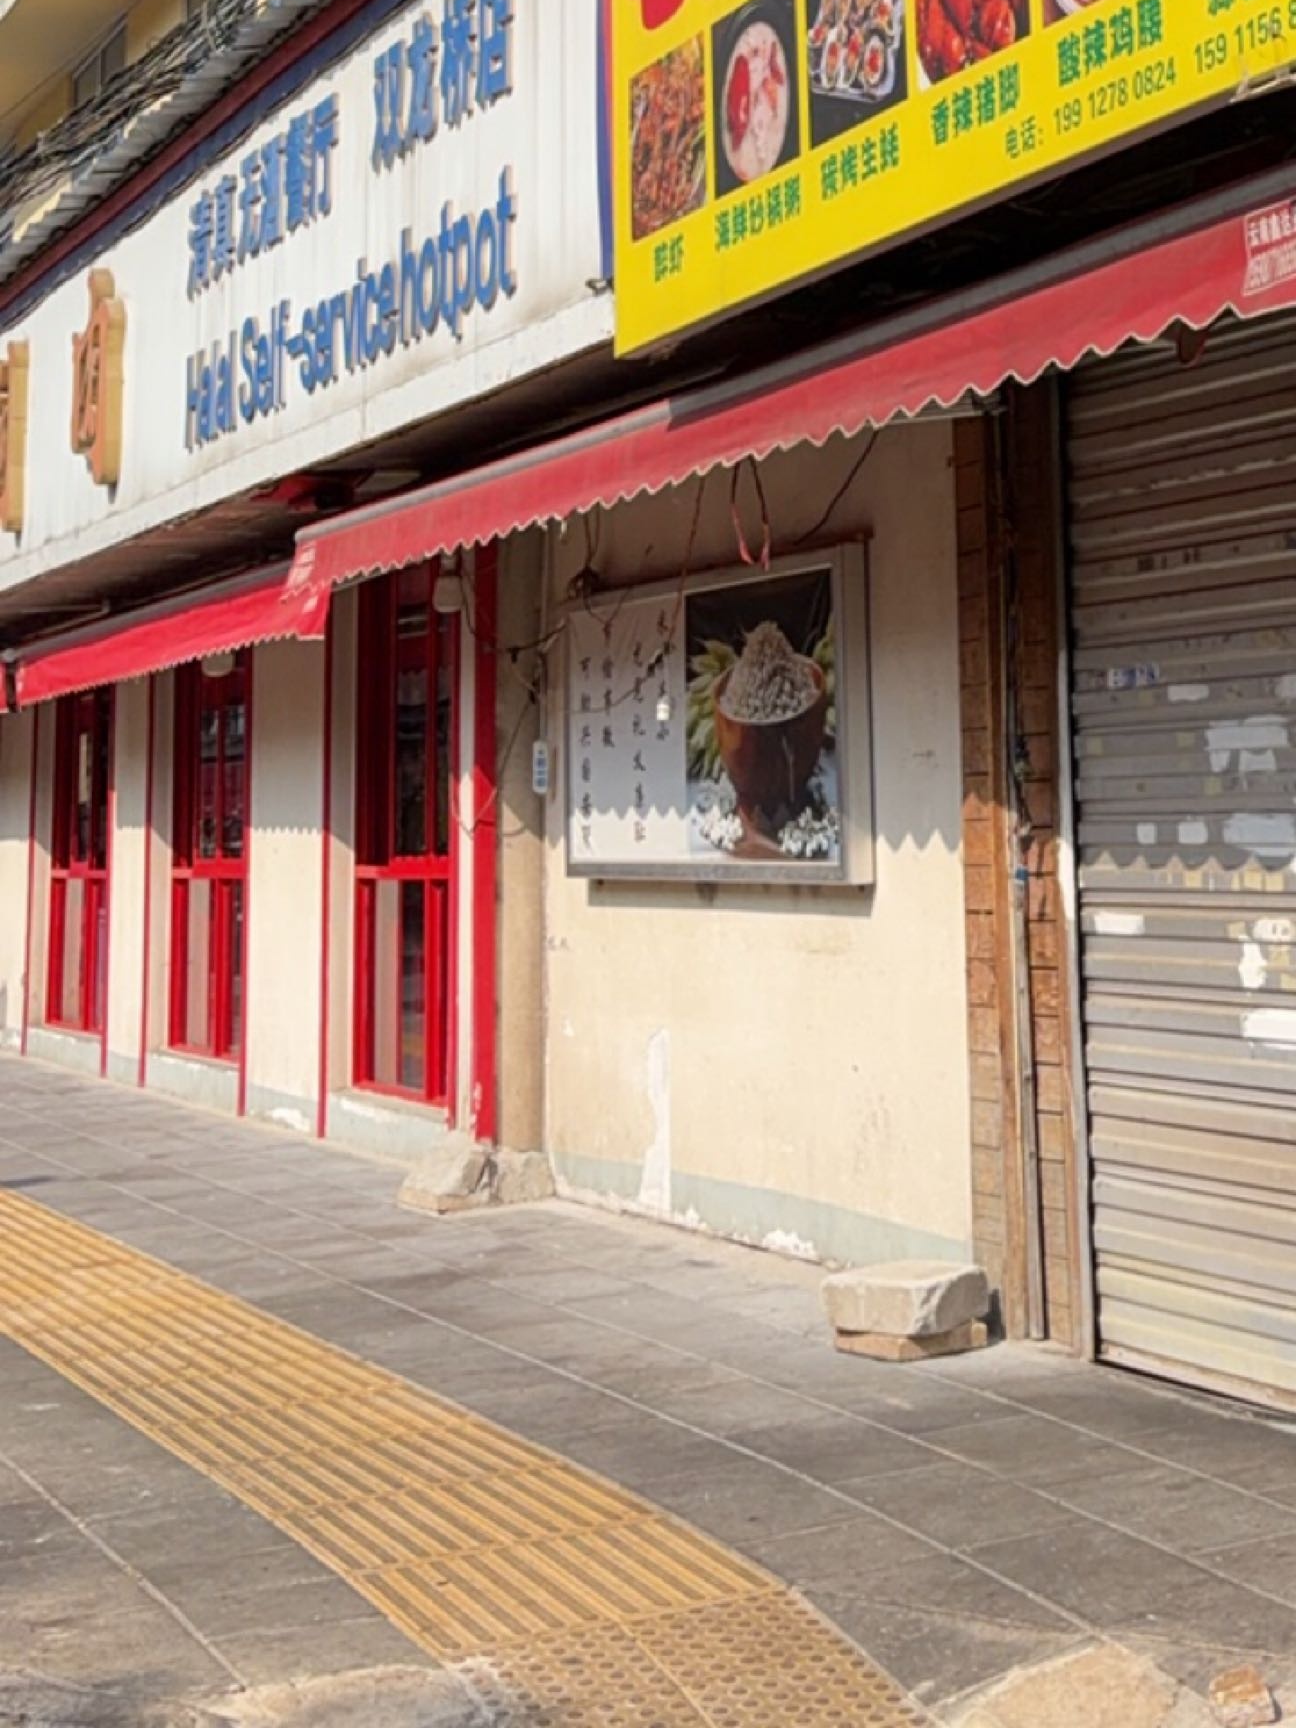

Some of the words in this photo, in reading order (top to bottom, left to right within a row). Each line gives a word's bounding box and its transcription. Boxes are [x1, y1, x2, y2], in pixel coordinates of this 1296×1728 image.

[932, 63, 1020, 146] 香辣猪脚
[1052, 97, 1083, 135] 199
[1088, 77, 1128, 119] 1278
[1132, 56, 1176, 100] 0824
[1194, 32, 1227, 73] 159
[1234, 5, 1284, 56] 1156
[820, 121, 900, 201] 碳烤生蚝
[714, 174, 801, 251] 海鲜砂锅粥
[653, 234, 684, 283] 醉虾
[185, 330, 237, 454] Halal
[239, 256, 397, 424] Self-service
[399, 165, 516, 349] hotpot
